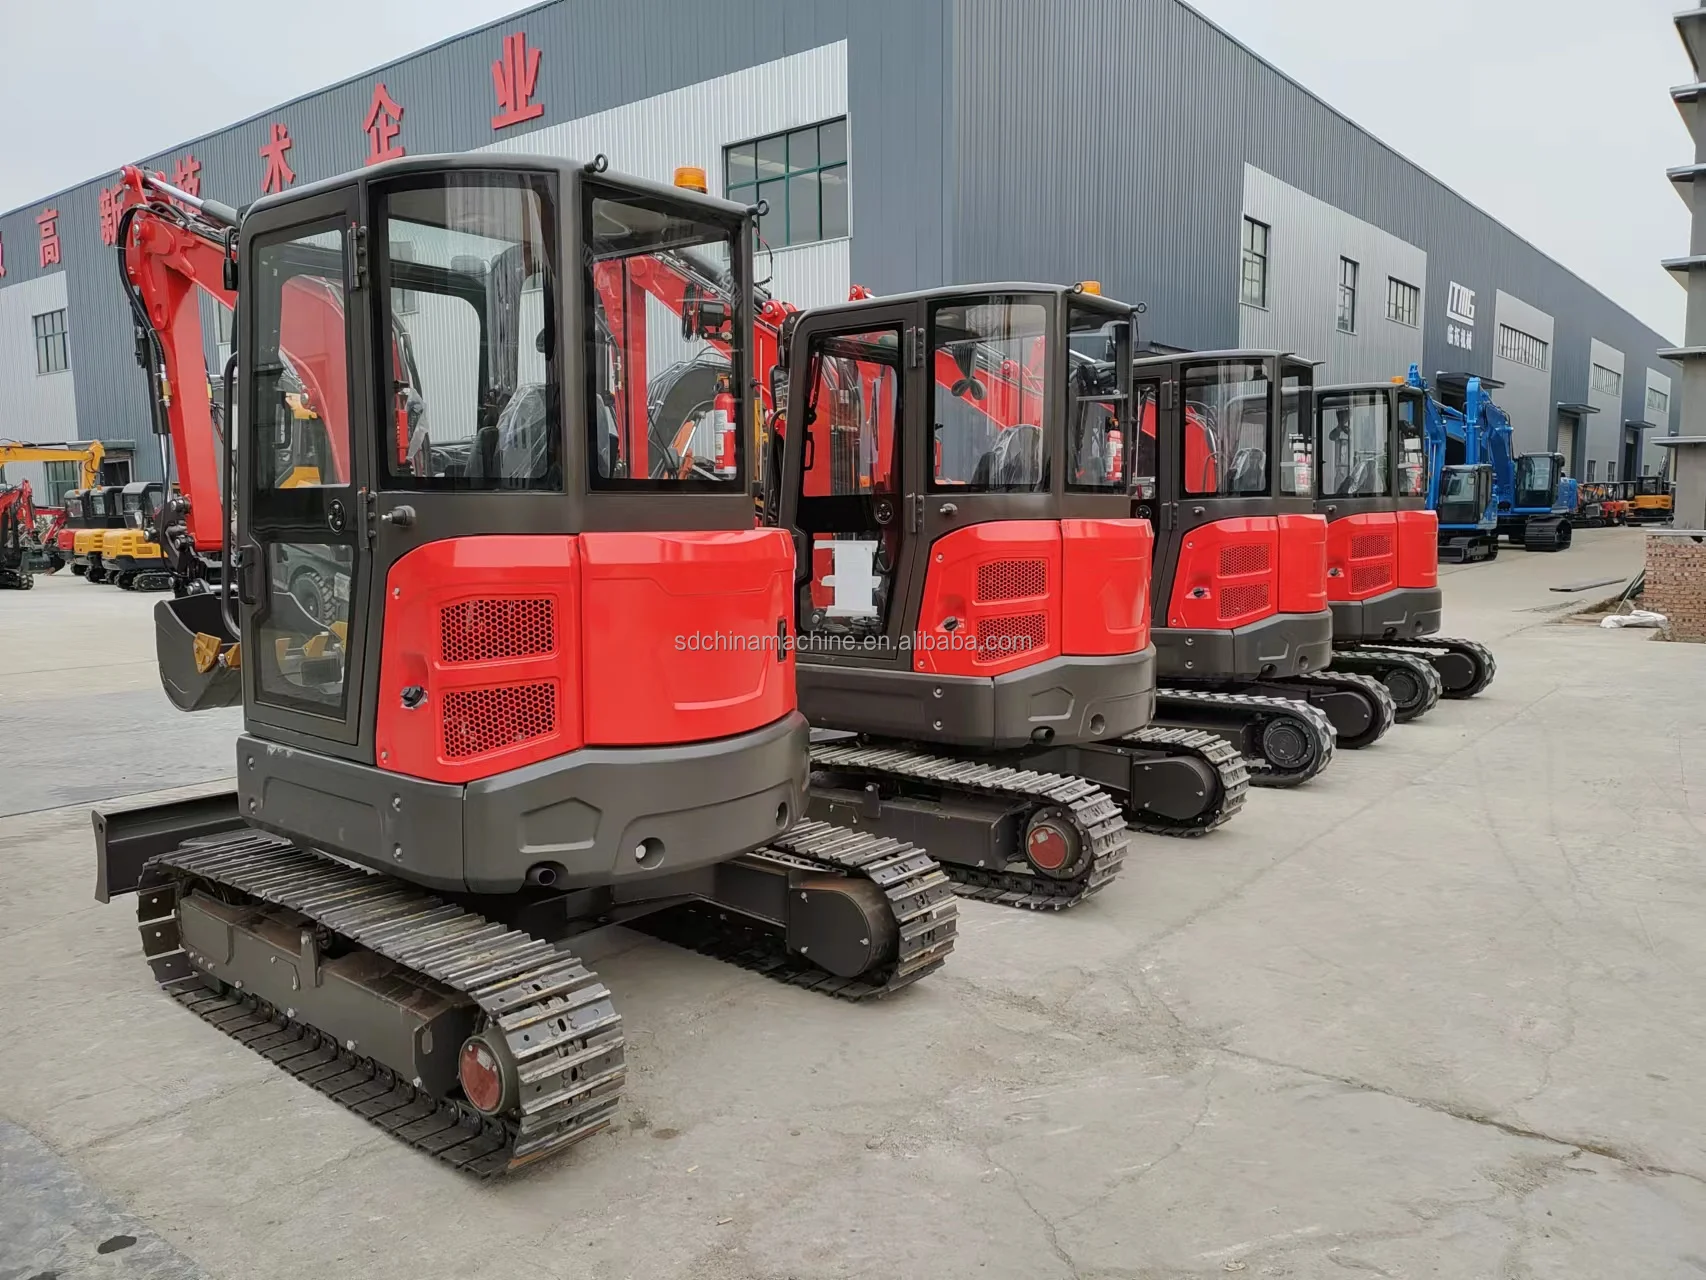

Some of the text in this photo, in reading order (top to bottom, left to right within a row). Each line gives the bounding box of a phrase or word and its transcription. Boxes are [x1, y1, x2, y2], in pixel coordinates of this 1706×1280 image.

[0, 31, 545, 278] 高新技术企业
